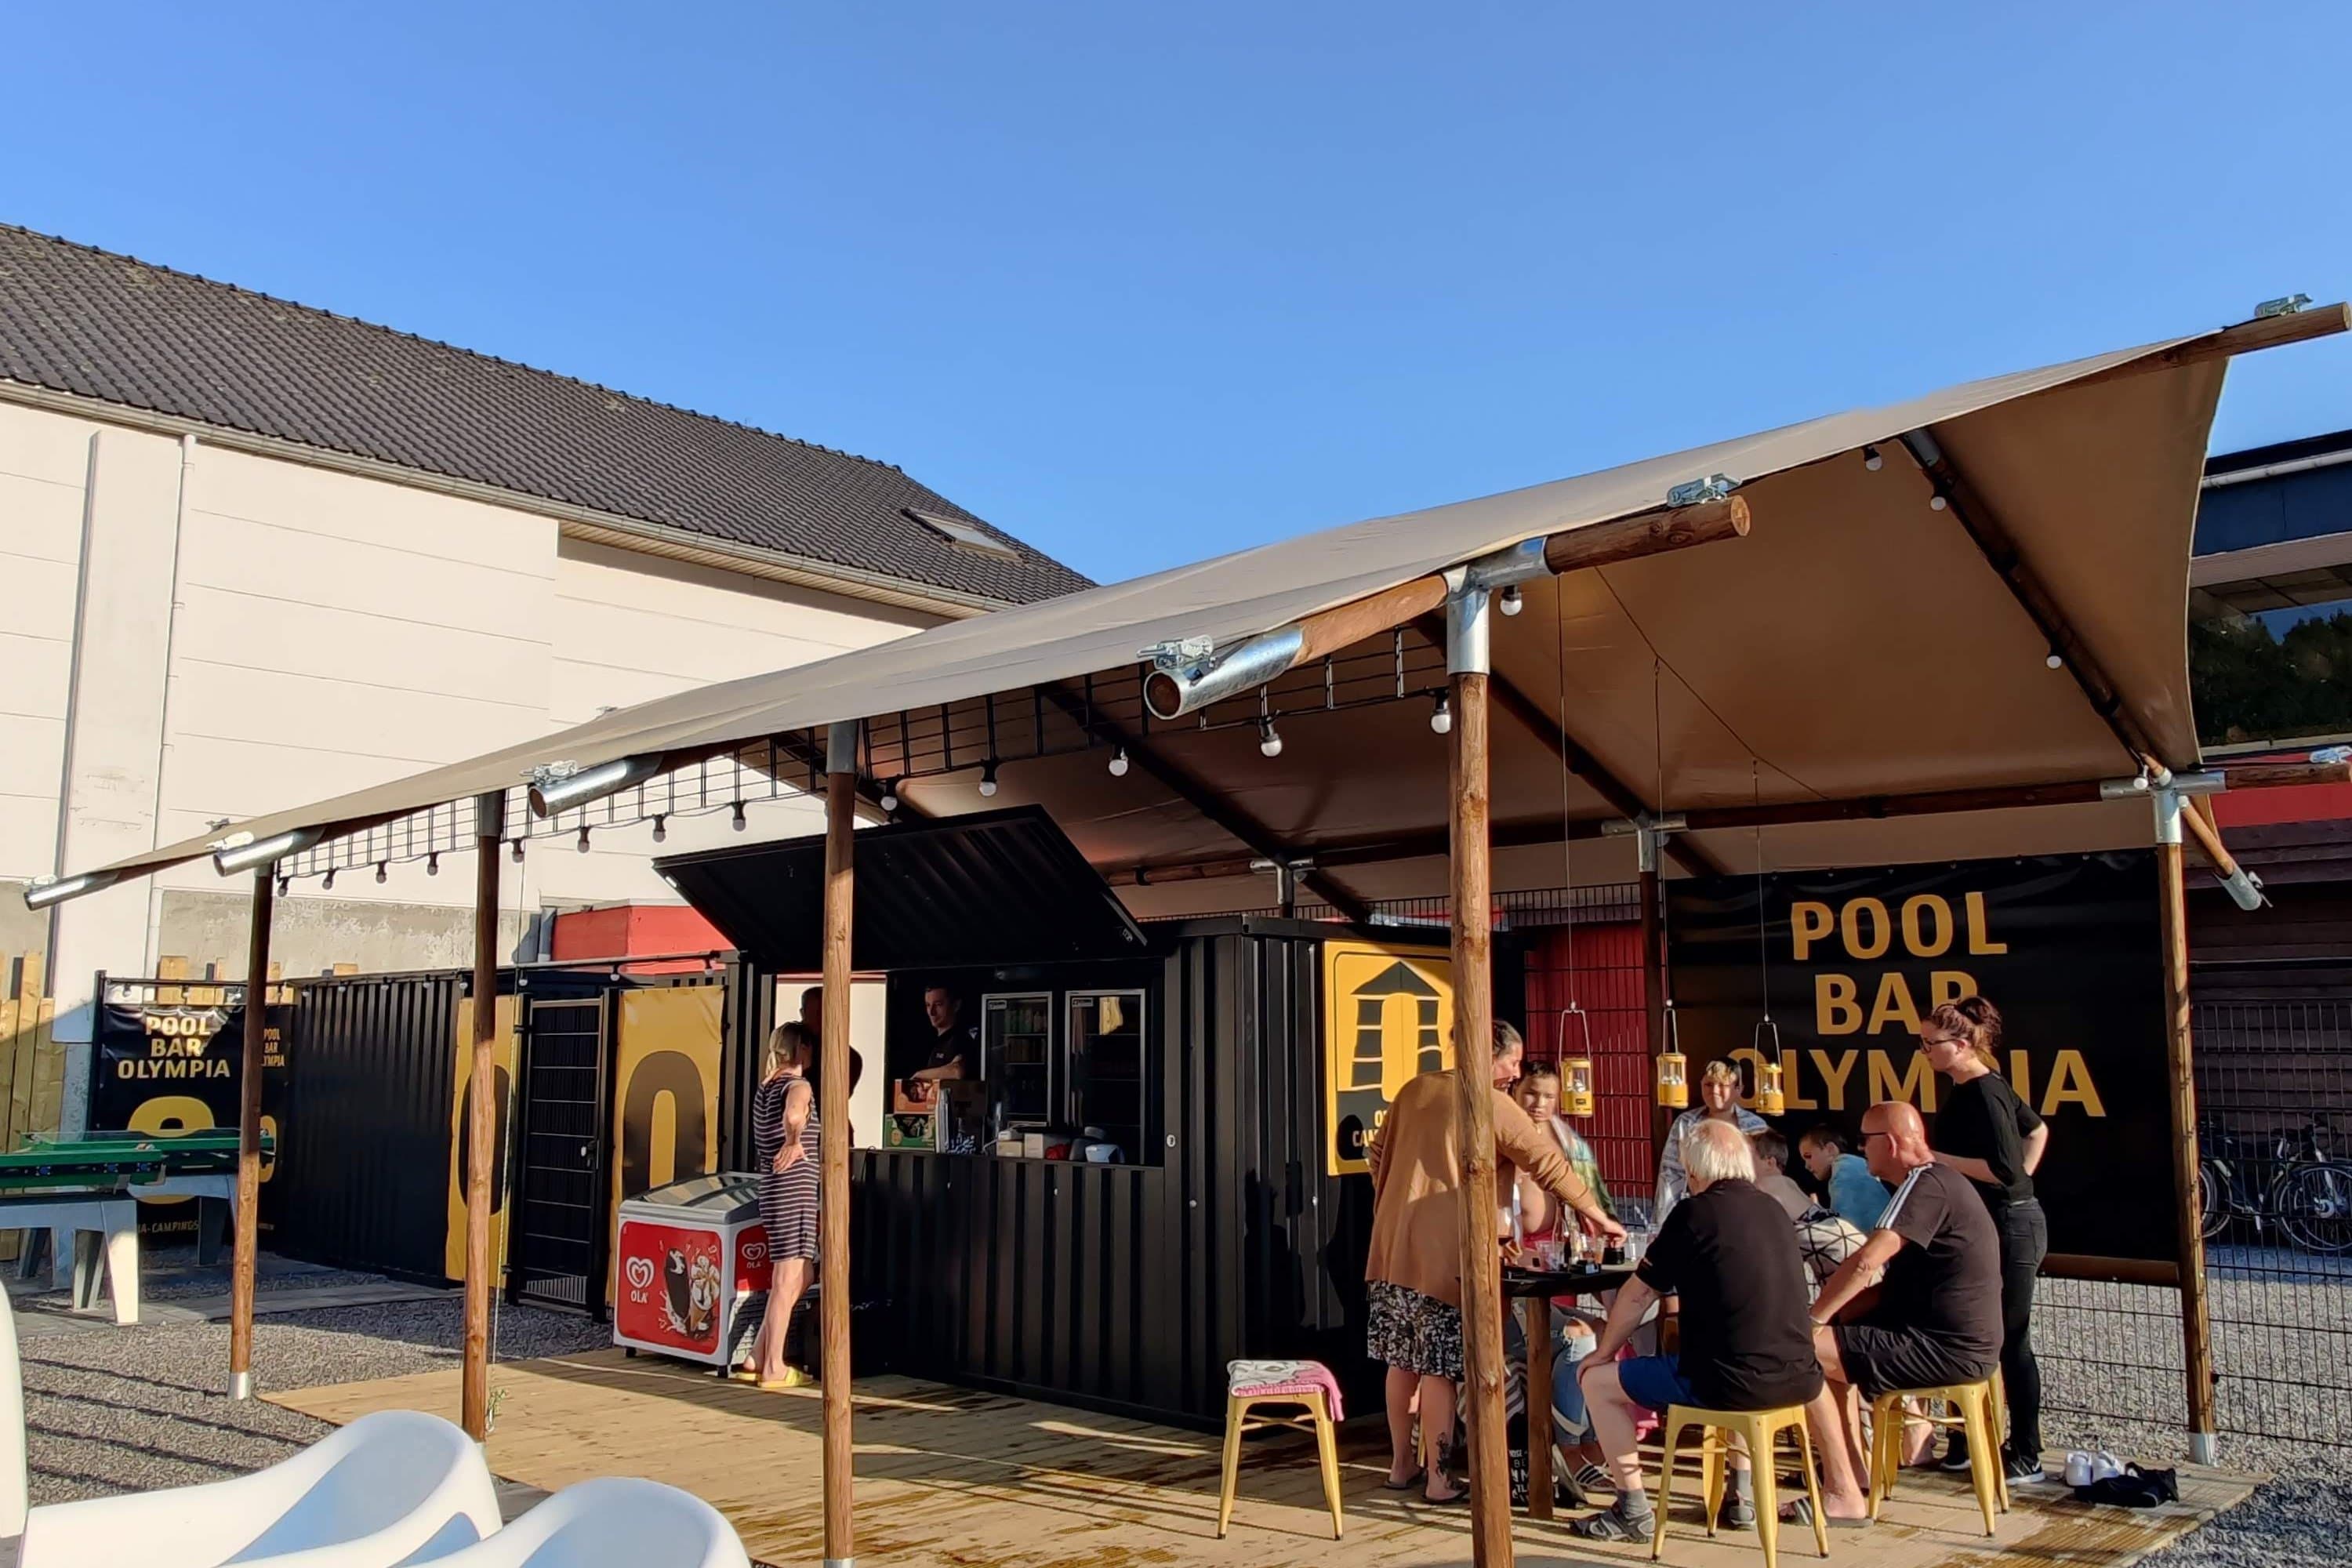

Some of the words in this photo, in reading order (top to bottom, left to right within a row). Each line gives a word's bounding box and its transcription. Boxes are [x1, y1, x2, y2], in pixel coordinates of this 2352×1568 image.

[1791, 891, 2008, 960] POOL
[146, 1016, 211, 1036] POOL
[151, 1038, 201, 1057] BAR
[118, 1058, 231, 1079] OLYMPIA
[1725, 1047, 2106, 1117] OLYMIA
[630, 1290, 648, 1303] OLA
